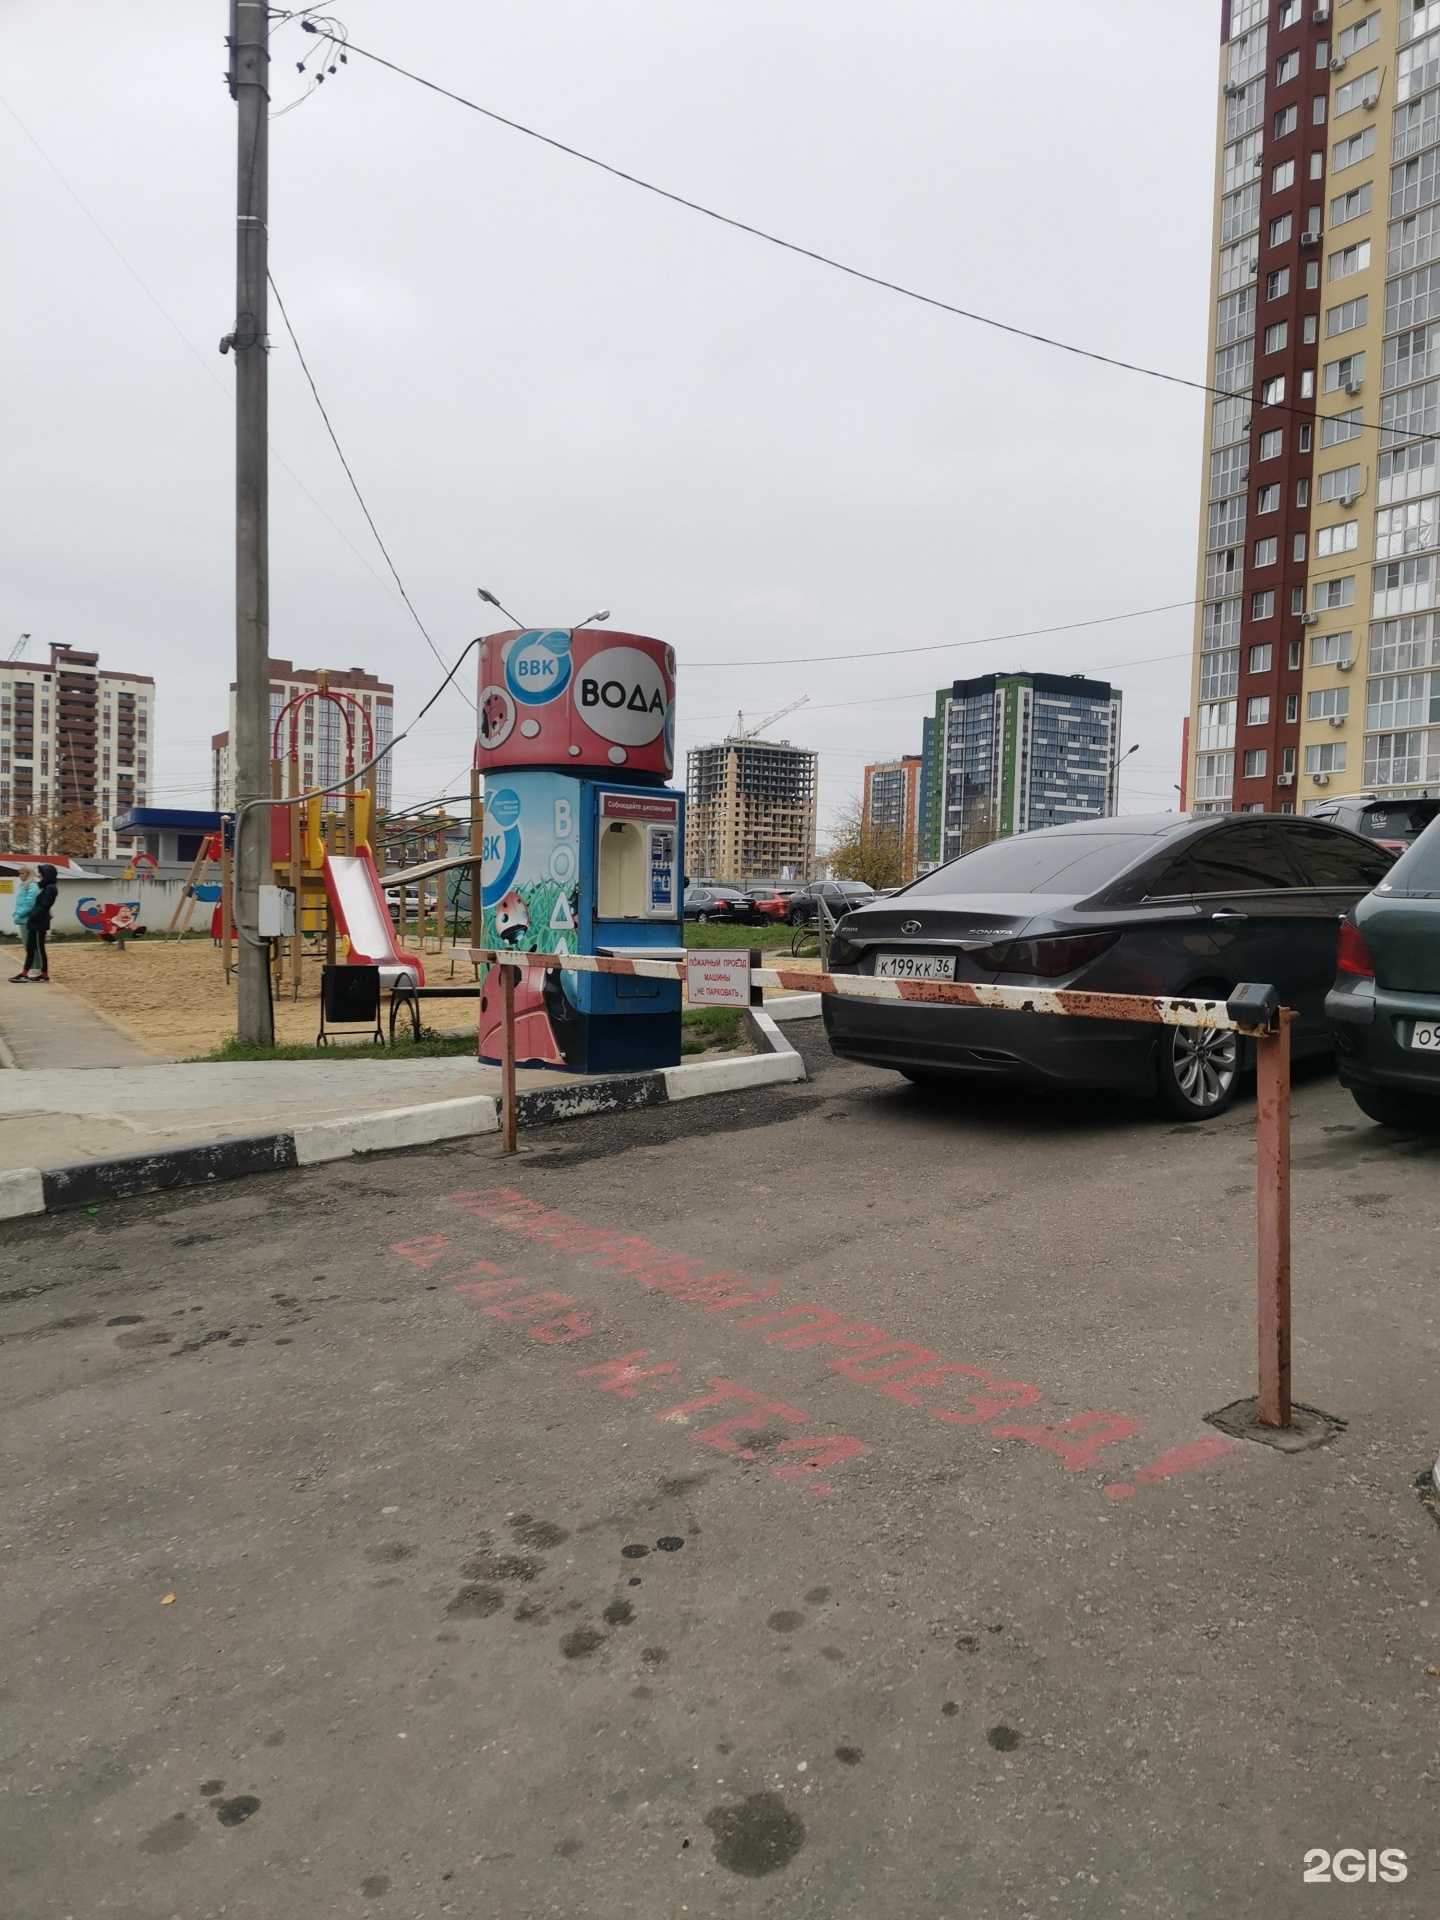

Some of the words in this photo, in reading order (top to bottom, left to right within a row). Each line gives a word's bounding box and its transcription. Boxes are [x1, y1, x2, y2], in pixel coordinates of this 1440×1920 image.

[518, 660, 554, 676] ВВК
[581, 679, 665, 716] ВОДА
[935, 959, 950, 973] 36
